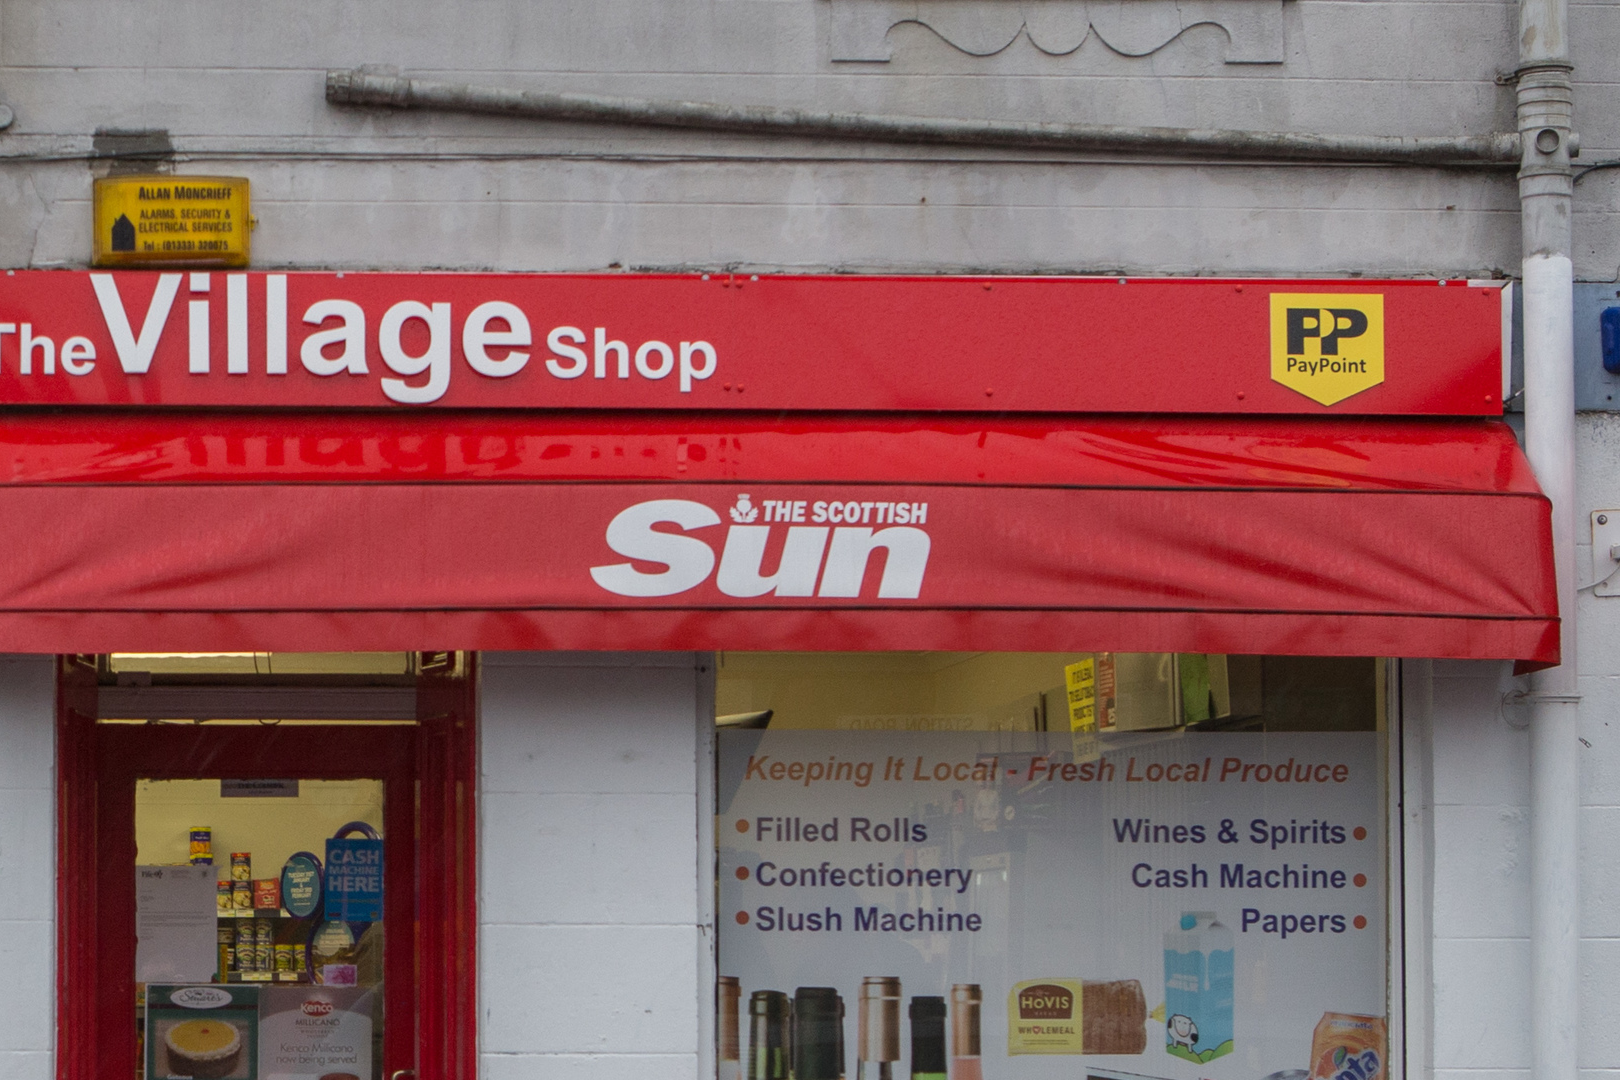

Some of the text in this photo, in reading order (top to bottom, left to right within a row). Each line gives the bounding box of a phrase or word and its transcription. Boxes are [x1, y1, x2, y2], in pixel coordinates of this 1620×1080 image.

[138, 186, 232, 200] ALLAN MONCRIEFF
[181, 209, 222, 219] SECURITY
[224, 210, 230, 219] &
[138, 222, 233, 233] ELECTRICAL SERVICES
[90, 273, 532, 404] Village
[545, 326, 718, 393] Shop
[1286, 356, 1367, 376] PayPoint
[762, 500, 928, 524] THE SCOTTISH
[745, 756, 872, 787] Keeping
[884, 756, 906, 781] It
[913, 756, 998, 782] Local
[1026, 756, 1115, 783] Fresh
[1125, 757, 1210, 783] Local
[1217, 757, 1350, 784] Produce
[756, 817, 928, 844] Filled Rolls
[1113, 818, 1347, 850] Wines & Spirits
[330, 850, 379, 864] CASH
[329, 865, 379, 875] MACHINE
[755, 862, 973, 893] Confectionery
[1131, 863, 1347, 890] Cash Machine
[329, 876, 379, 892] HERE
[755, 907, 982, 933] Slush Machine
[1241, 909, 1347, 939] Papers
[301, 1003, 333, 1013] Kenco
[327, 1053, 357, 1063] served
